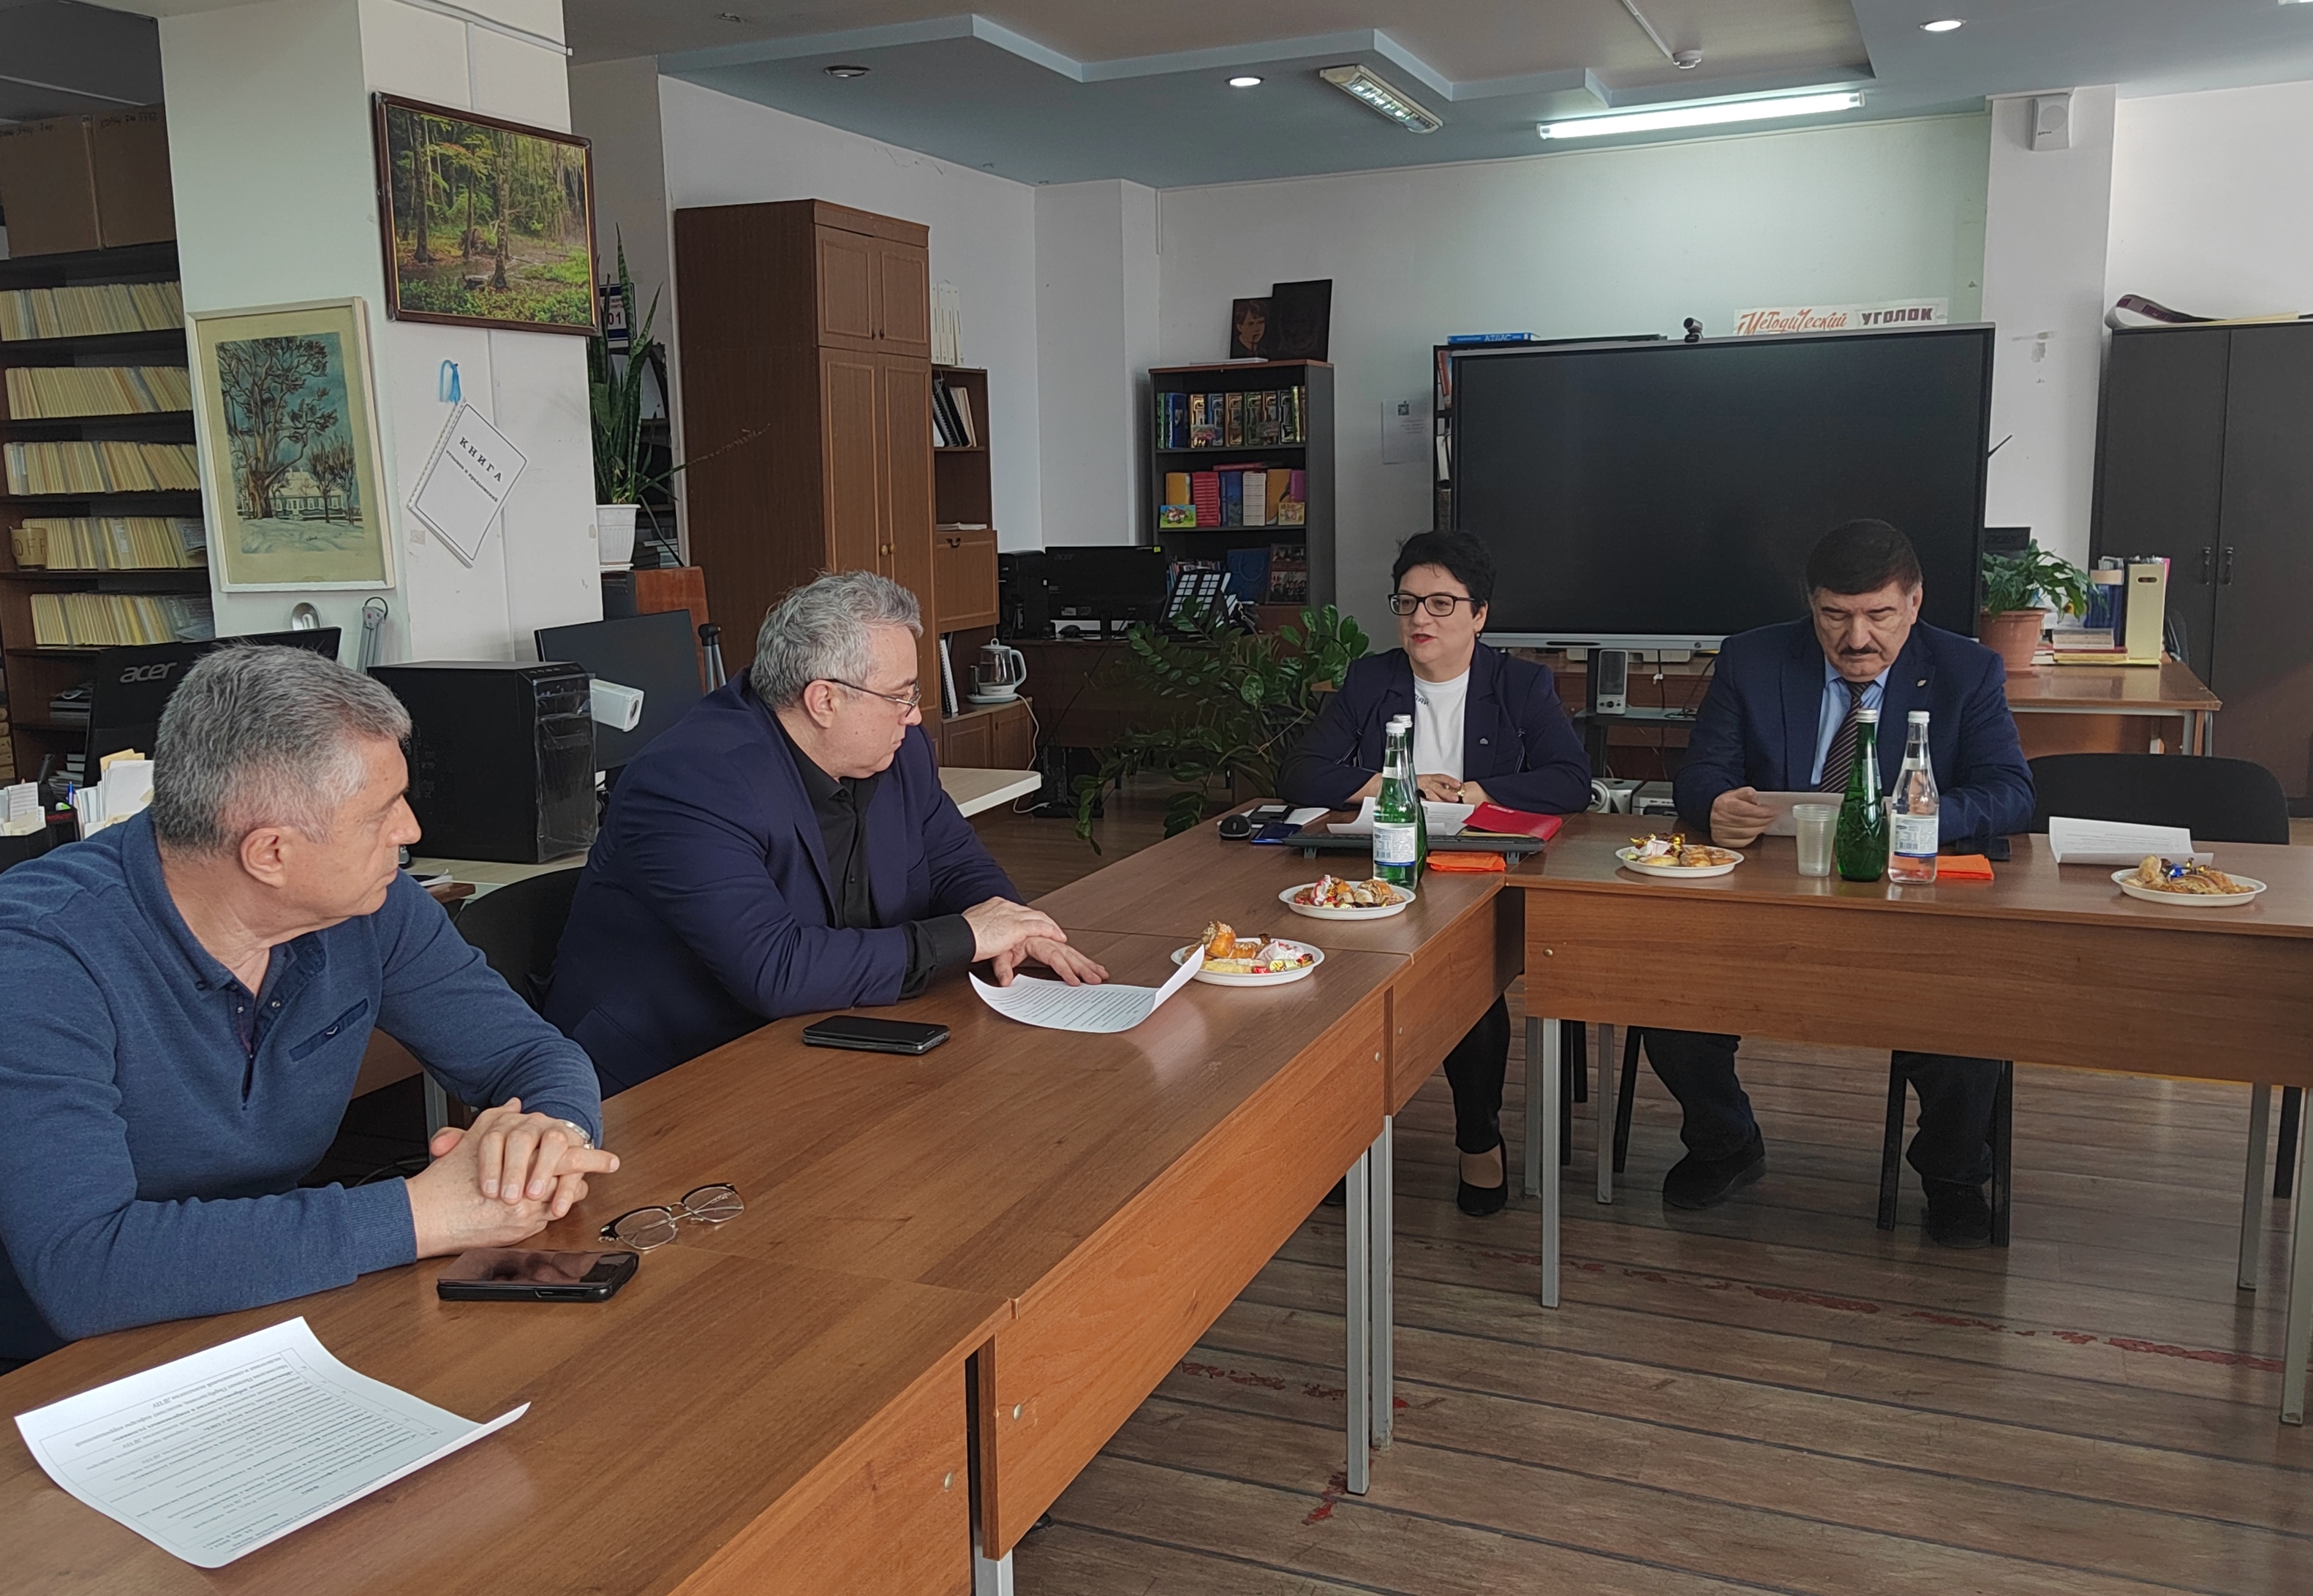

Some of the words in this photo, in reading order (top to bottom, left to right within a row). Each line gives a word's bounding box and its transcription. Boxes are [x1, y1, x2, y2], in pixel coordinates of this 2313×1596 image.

[608, 311, 622, 325] 01
[1861, 308, 1933, 325] УГОЛОК
[459, 436, 502, 483] КНИГА
[119, 662, 178, 684] acer
